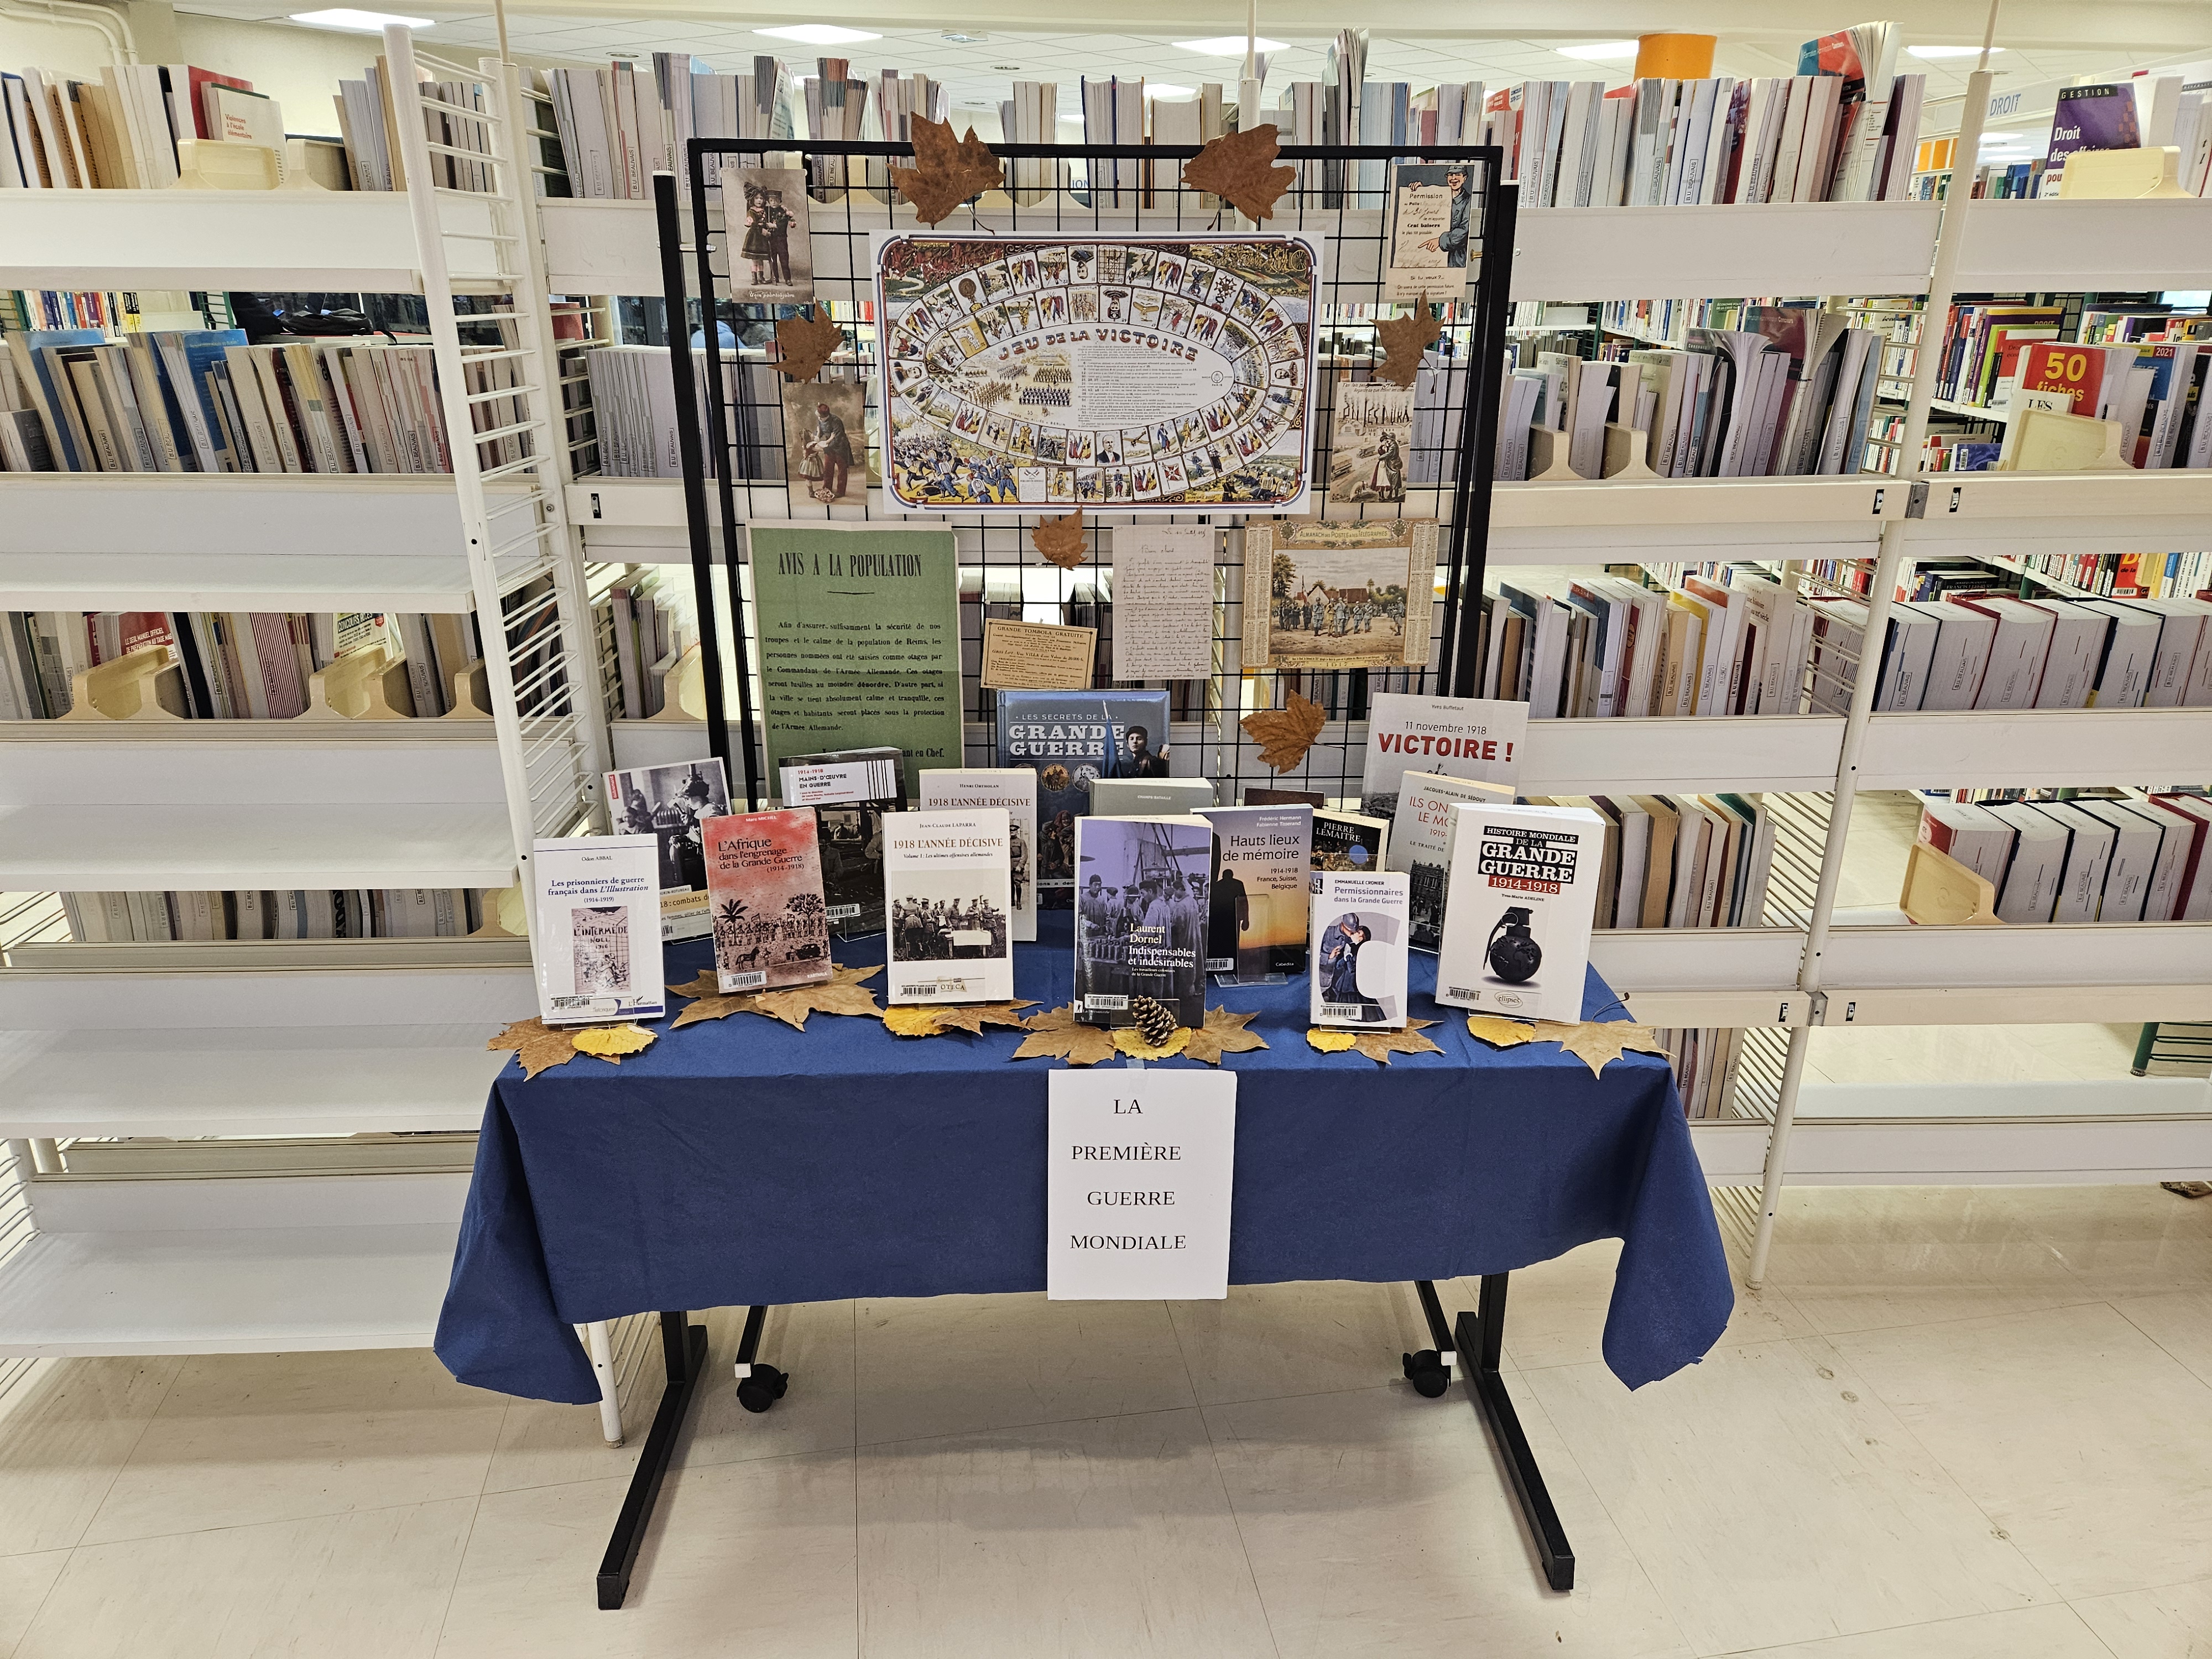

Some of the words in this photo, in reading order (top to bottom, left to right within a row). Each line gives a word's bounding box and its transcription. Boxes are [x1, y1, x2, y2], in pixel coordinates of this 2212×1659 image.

[2062, 88, 2110, 99] GESTION
[1990, 93, 2021, 116] DROIT
[2054, 126, 2081, 141] Droit
[1688, 162, 1697, 188] BEAUVAIS
[2047, 174, 2062, 185] pou
[998, 336, 1039, 361] JEU
[1046, 332, 1067, 346] DE
[1071, 330, 1089, 342] LA
[1095, 328, 1198, 362] VICTOIRE
[2156, 347, 2173, 357] 2021
[2045, 353, 2086, 382] 50
[1666, 429, 1676, 452] BEAUVAIS
[779, 552, 804, 575] AVIS
[813, 554, 820, 575] A
[830, 554, 842, 576] LA
[850, 554, 921, 577] POPULATION
[1009, 726, 1125, 739] GRANDE
[1416, 724, 1463, 733] novembre
[1468, 726, 1486, 734] 1918
[1378, 733, 1498, 761] VICTOIRE
[1505, 742, 1514, 762] !
[1424, 786, 1458, 797] JACQUES-ALAIN
[1467, 794, 1486, 803] SÉDOUY
[951, 797, 987, 806] L'ANNÉE
[989, 797, 1031, 806] DÉCISIVE
[1409, 796, 1424, 808] ILS
[1323, 822, 1354, 834] PIERRE
[1231, 836, 1265, 846] Hauts
[1270, 834, 1300, 845] lieux
[1486, 827, 1527, 837] HISTOIRE
[1529, 832, 1577, 843] MONDIALE
[718, 838, 772, 852] L'Afrique
[918, 837, 957, 848] L'ANNÉE
[959, 837, 1003, 848] DÉCISIVE
[740, 847, 787, 859] l'engrenage
[1223, 851, 1238, 861] de
[1243, 848, 1298, 860] mémoire
[1481, 843, 1575, 865] GRANDE
[742, 858, 771, 867] Grande
[774, 853, 802, 864] Guerre
[767, 864, 804, 873] (1914-1918)
[1480, 861, 1573, 883] GUERRE
[566, 879, 608, 888] prisonniers
[1491, 877, 1558, 894] 1914-1918
[549, 888, 577, 896] français
[1335, 887, 1403, 895] Permissionnaires
[673, 896, 701, 906] combats
[1130, 924, 1165, 934] Laurent
[1129, 934, 1162, 944] Dornel
[1128, 946, 1196, 958] Indispensables
[1128, 957, 1136, 966] et
[1139, 956, 1194, 968] indésirables
[1114, 1099, 1142, 1113] LA
[1072, 1142, 1180, 1160] PREMIÈRE
[1088, 1192, 1175, 1205] GUERRE
[1071, 1235, 1186, 1249] MONDIALE
